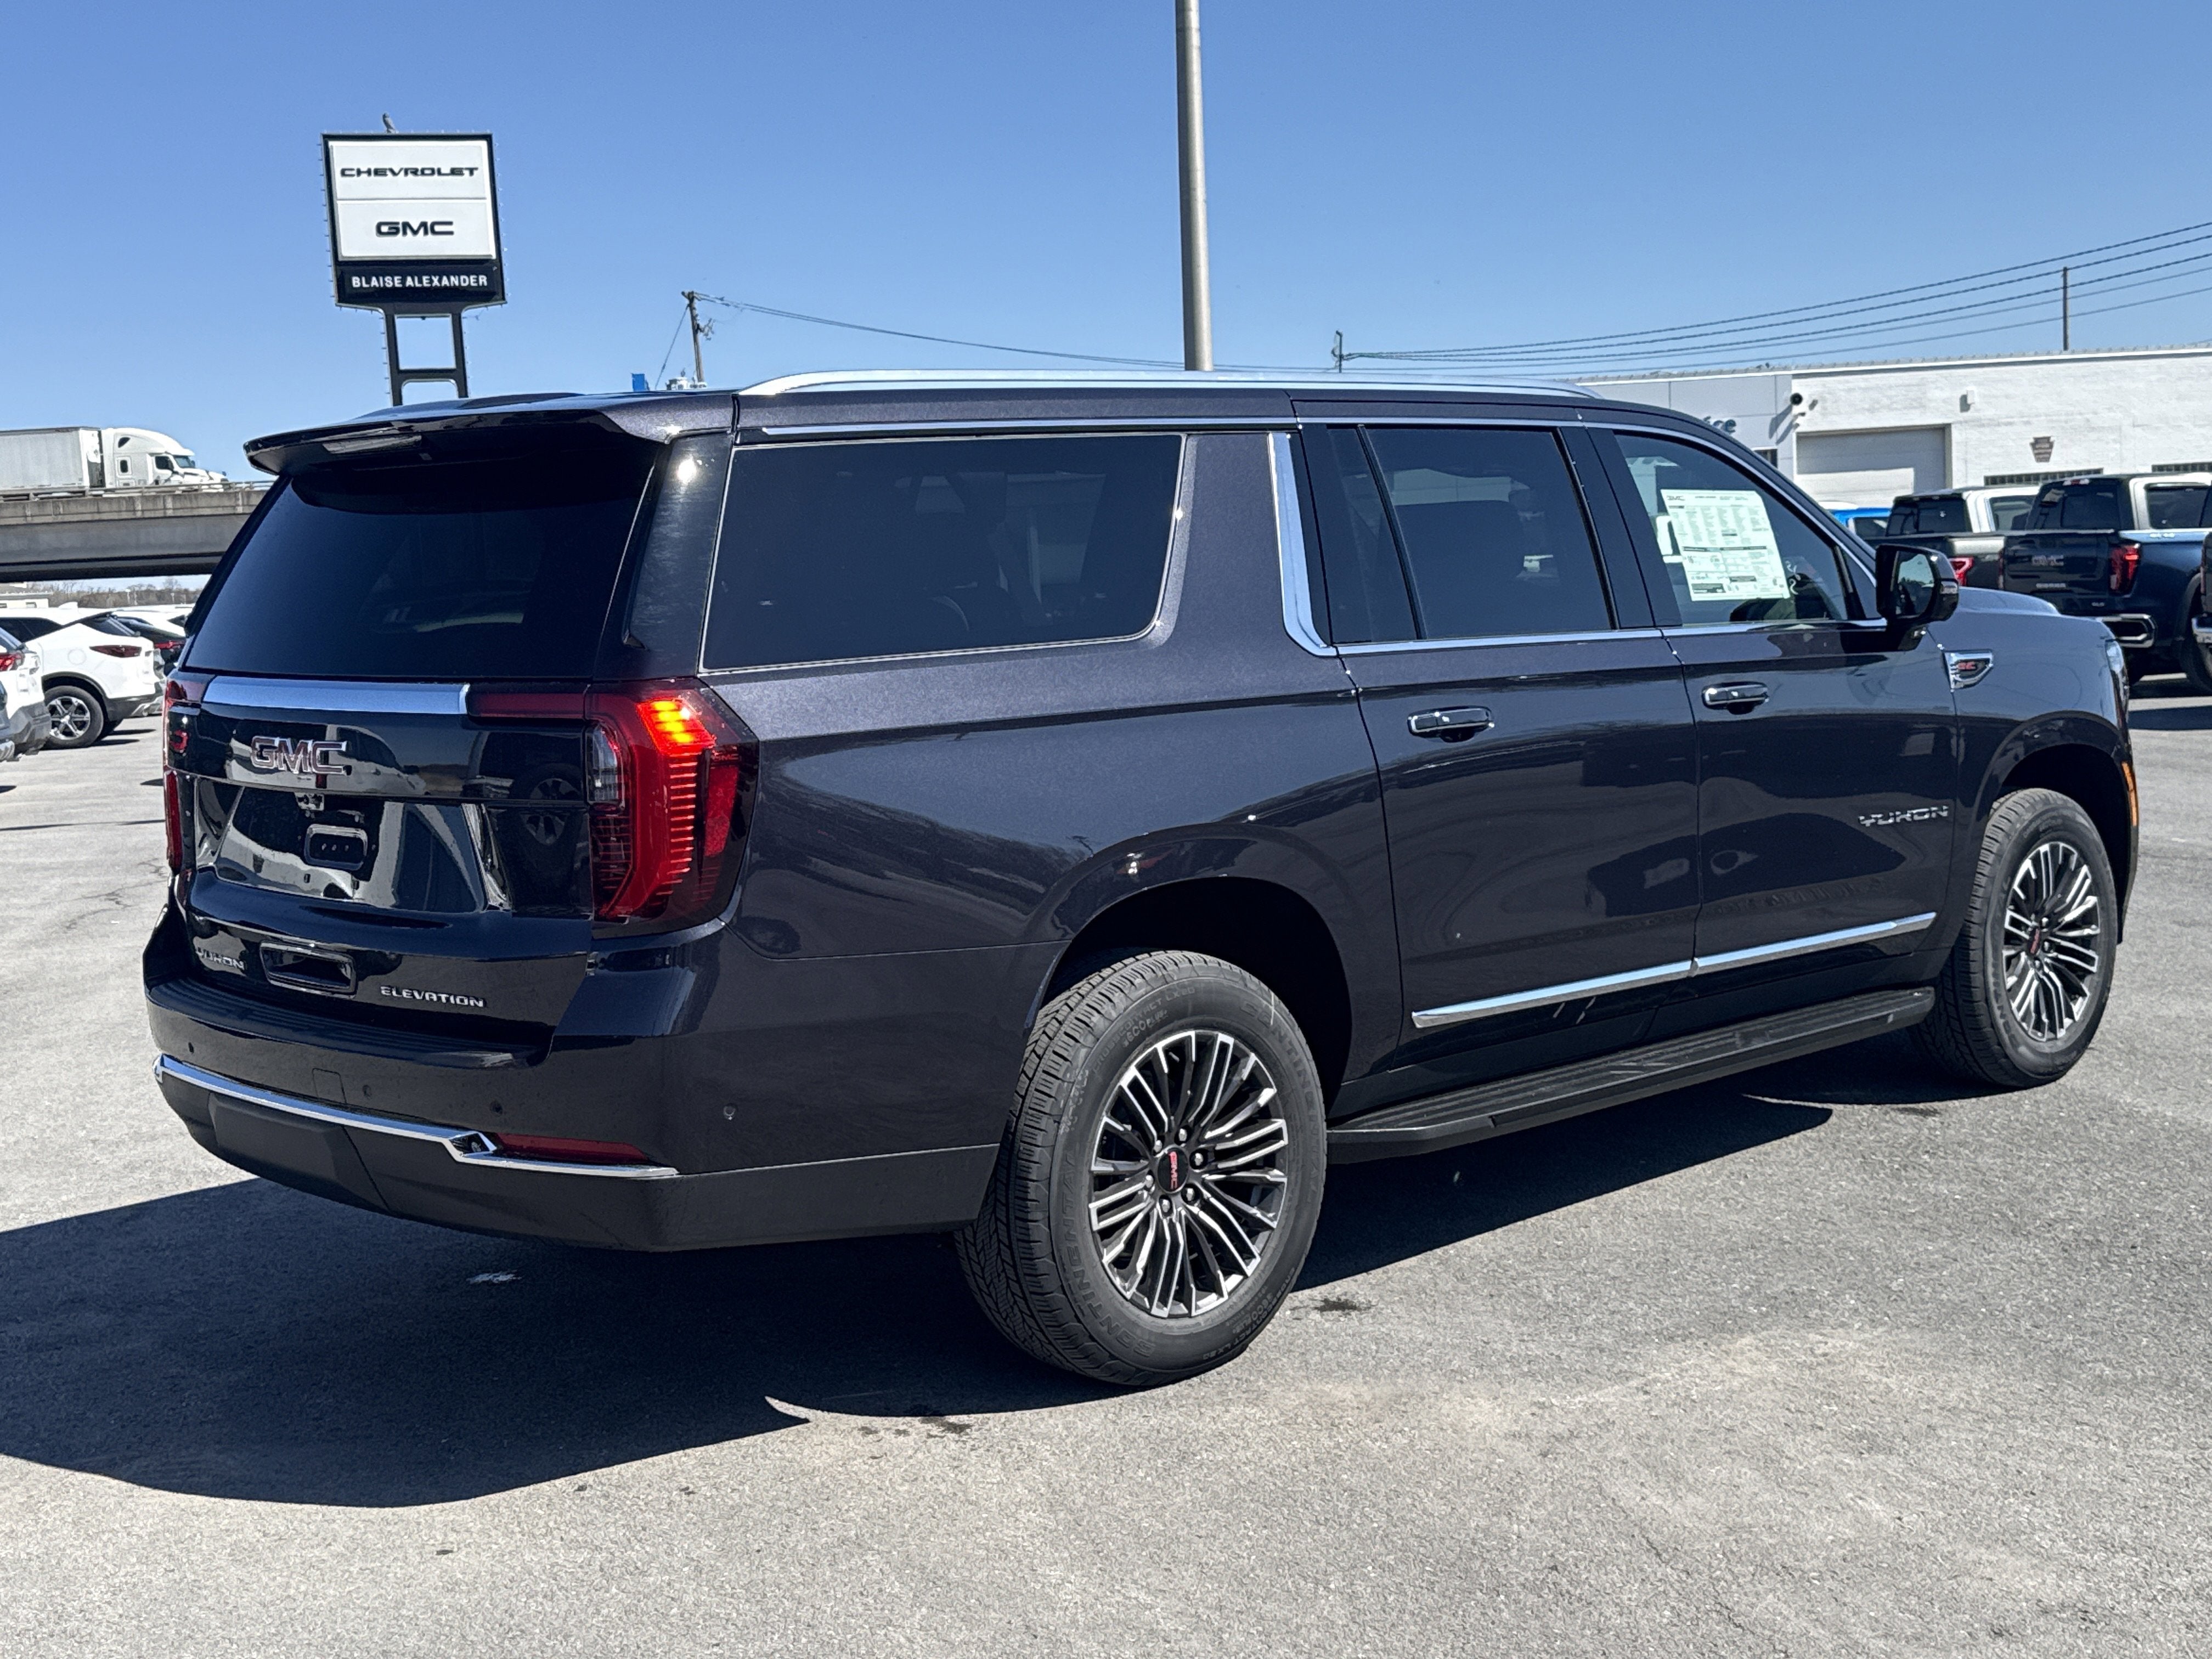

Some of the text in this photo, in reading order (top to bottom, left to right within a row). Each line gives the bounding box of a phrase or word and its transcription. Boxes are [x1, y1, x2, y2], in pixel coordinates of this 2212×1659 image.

[340, 166, 479, 177] CHEVROLET
[375, 221, 454, 237] GMC
[352, 275, 488, 288] BLAISE ALEXANDER
[250, 736, 347, 776] GMC
[1858, 805, 1949, 827] YUKON
[195, 946, 245, 970] YUKON
[380, 986, 486, 1007] ELEVATION
